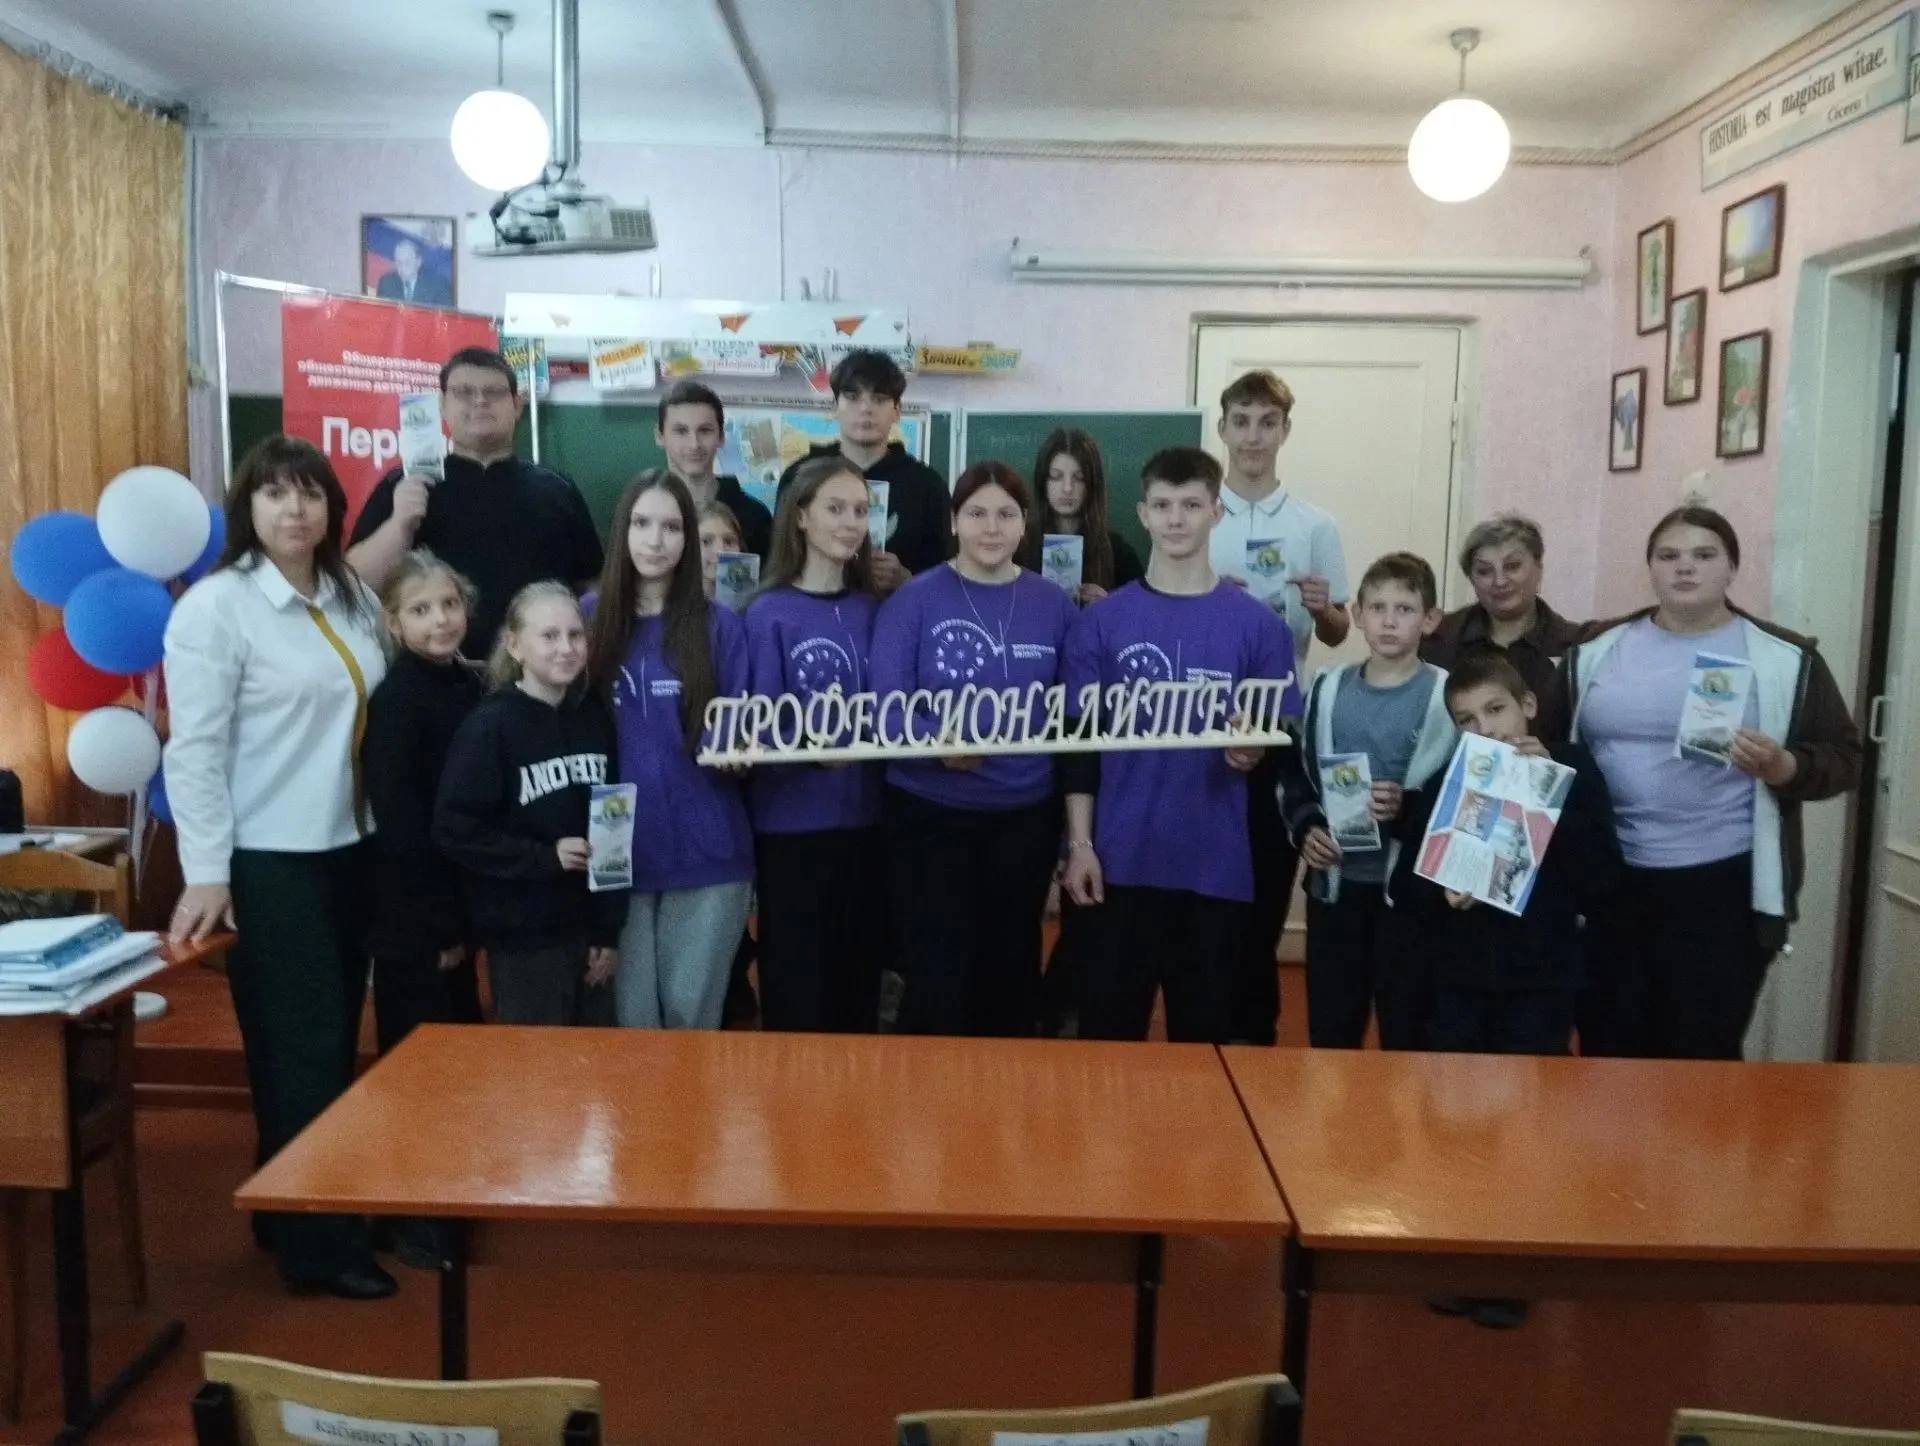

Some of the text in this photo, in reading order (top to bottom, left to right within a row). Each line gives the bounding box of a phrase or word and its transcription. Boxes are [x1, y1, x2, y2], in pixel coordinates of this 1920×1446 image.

[1709, 113, 1748, 155] HISTORIA
[1781, 71, 1836, 117] magistra
[342, 350, 442, 375] Общероссийско
[703, 672, 1294, 755] ПРОФЕССИОНАЛИТЕТ
